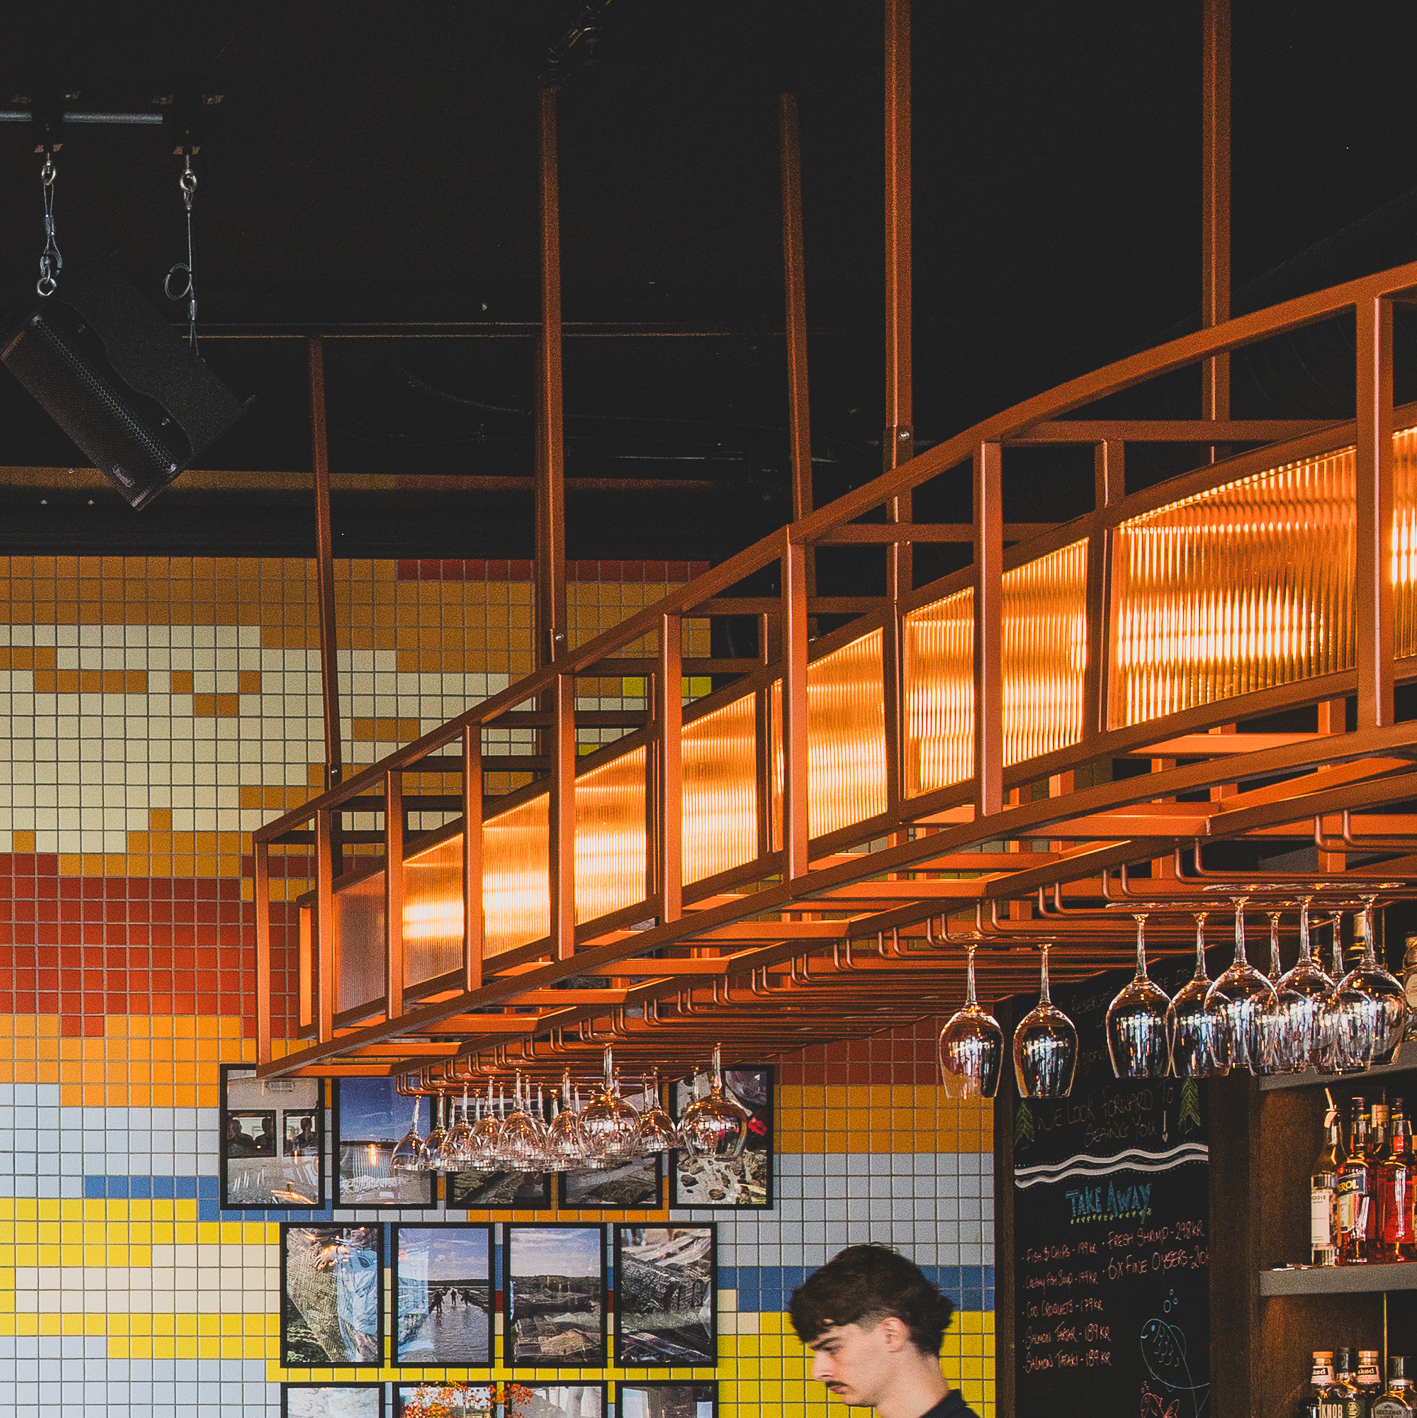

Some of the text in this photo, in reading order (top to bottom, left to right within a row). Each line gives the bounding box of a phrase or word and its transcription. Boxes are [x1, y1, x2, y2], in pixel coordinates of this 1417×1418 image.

[1067, 1095, 1096, 1125] LOOK
[1101, 1085, 1154, 1118] FORWARD
[1065, 1180, 1152, 1224] TAKE AWAY
[1107, 1230, 1134, 1250] FRESH
[1125, 1254, 1148, 1275] FINE
[1321, 1404, 1343, 1418] KNOB
